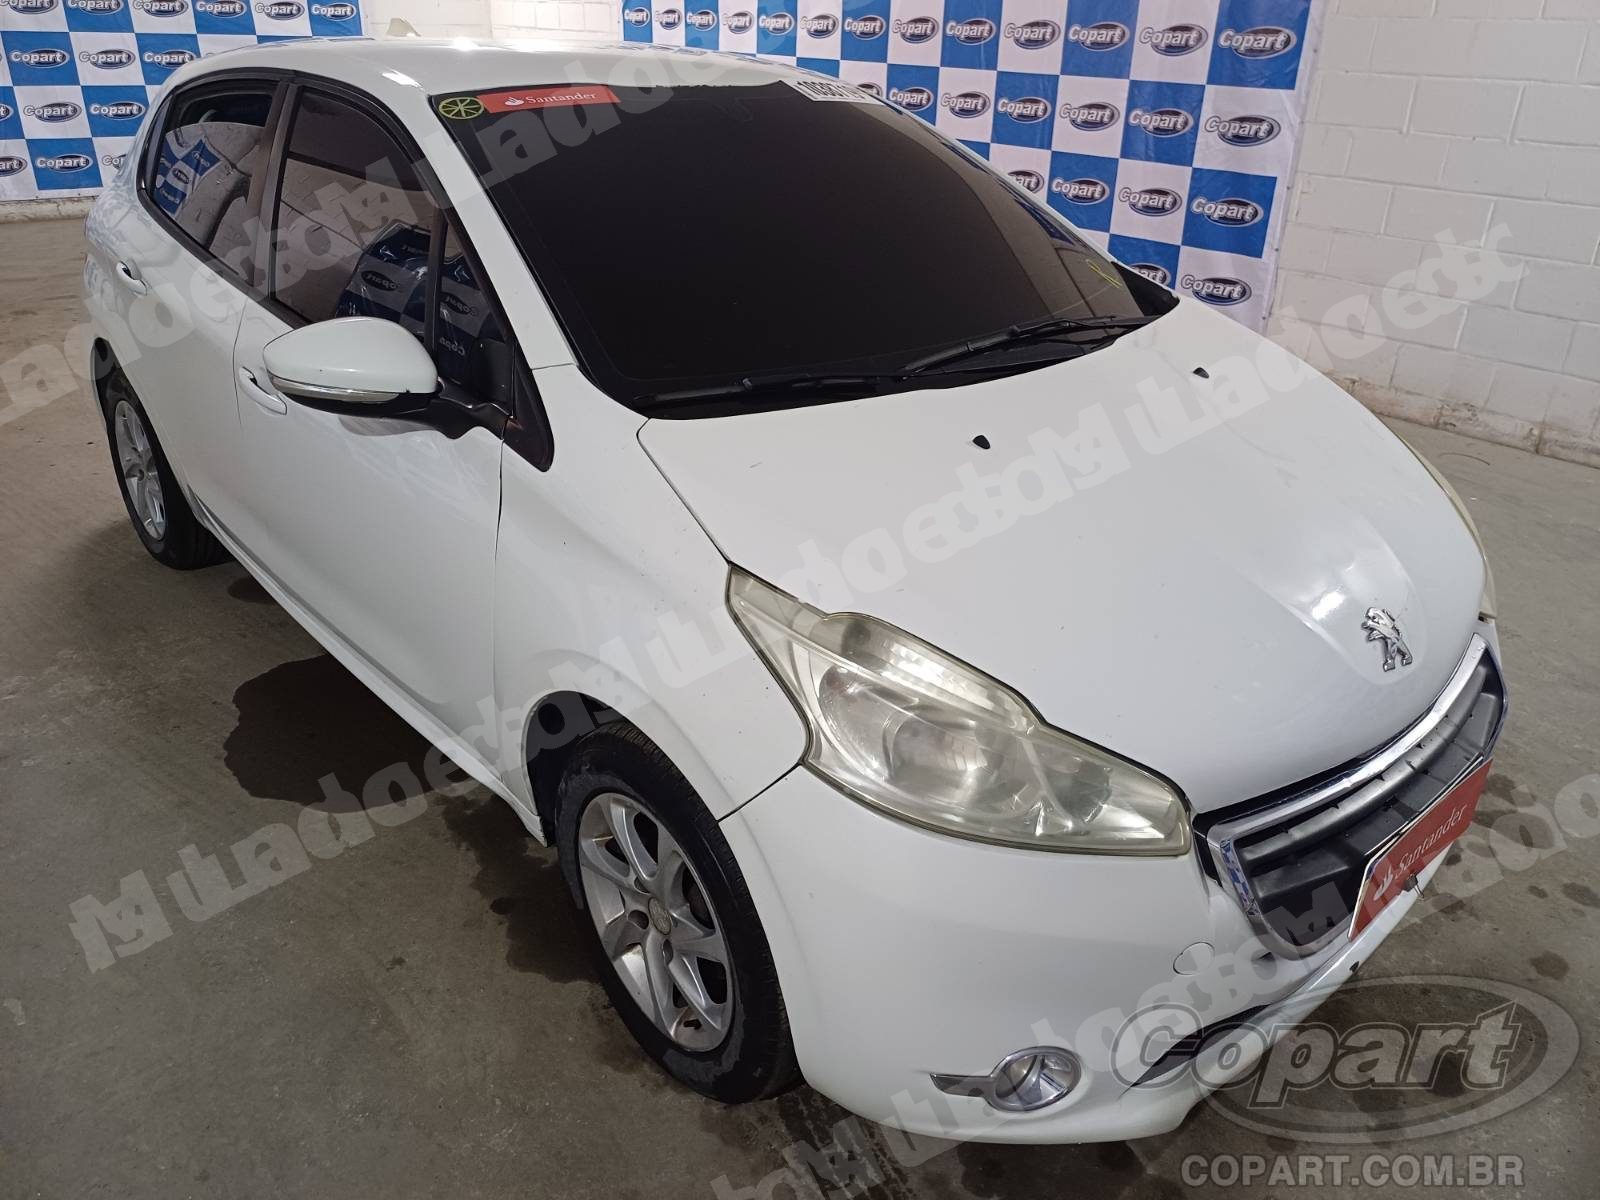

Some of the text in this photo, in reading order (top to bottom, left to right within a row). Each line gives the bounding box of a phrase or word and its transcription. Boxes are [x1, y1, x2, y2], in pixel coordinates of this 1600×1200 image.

[68, 0, 119, 11] Copart
[133, 0, 182, 12] Copart
[196, 1, 242, 13] Copart
[255, 3, 299, 16] Copart
[312, 4, 352, 16] Copart
[686, 11, 713, 25] Copart
[759, 16, 790, 30] Copart
[800, 16, 833, 32] Copart
[844, 18, 881, 34] Copart
[893, 20, 932, 37] Copart
[946, 21, 989, 38] Copart
[1004, 23, 1053, 43] Copart
[1069, 24, 1122, 46] Copart
[1139, 26, 1198, 48] Copart
[1219, 29, 1286, 51] Copart
[11, 51, 63, 64] Copart
[78, 51, 128, 64] Copart
[143, 52, 191, 64] Copart
[525, 90, 597, 104] Santander
[890, 89, 929, 108] Copart
[941, 93, 983, 112] Copart
[23, 104, 76, 118] Copart
[90, 103, 140, 118] Copart
[998, 100, 1045, 120] Copart
[1060, 104, 1111, 126] Copart
[1129, 110, 1186, 133] Copart
[1205, 116, 1269, 141] Copart
[36, 157, 88, 169] Copart
[1052, 178, 1103, 200] Copart
[1119, 187, 1174, 211] Copart
[1192, 197, 1254, 222] Copart
[1182, 274, 1243, 300] Copart
[1395, 804, 1468, 879] Santander
